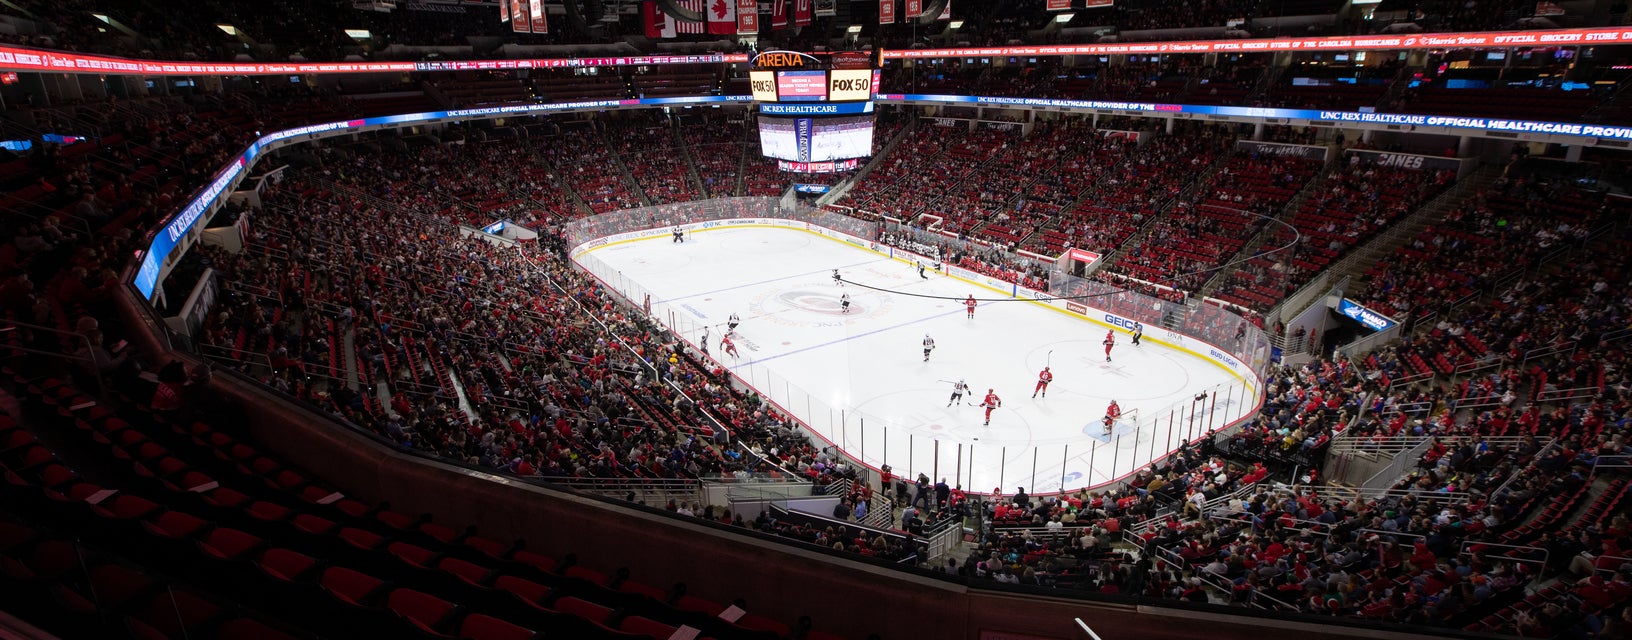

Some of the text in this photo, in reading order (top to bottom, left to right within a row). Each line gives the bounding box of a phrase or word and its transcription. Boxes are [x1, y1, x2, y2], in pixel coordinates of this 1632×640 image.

[1354, 38, 1401, 47] HURRICANES
[1428, 36, 1457, 45] Harris
[1457, 36, 1487, 44] Teeter
[1493, 34, 1537, 43] OFFICIAL
[1539, 33, 1583, 42] GROCERY
[1585, 31, 1619, 41] STORE
[758, 52, 804, 68] ARENA
[752, 80, 775, 93] FOX 50
[832, 78, 855, 92] FOX
[854, 78, 870, 92] 50
[529, 103, 568, 111] HEALTHCARE
[762, 105, 838, 113] UNC REX HEALTHCARE
[934, 118, 956, 127] CANES
[1320, 111, 1341, 120] UNC
[1341, 113, 1361, 121] REX
[1361, 114, 1425, 125] HEALTHCARE
[1427, 117, 1487, 128] OFFICIAL
[1487, 120, 1582, 135] HEALTHCARE
[1377, 153, 1424, 169] CANES
[1067, 303, 1086, 314] Lenovo
[1360, 310, 1388, 328] MAKO
[1167, 331, 1183, 341] DNA
[1210, 349, 1239, 368] BUD LIGHT
